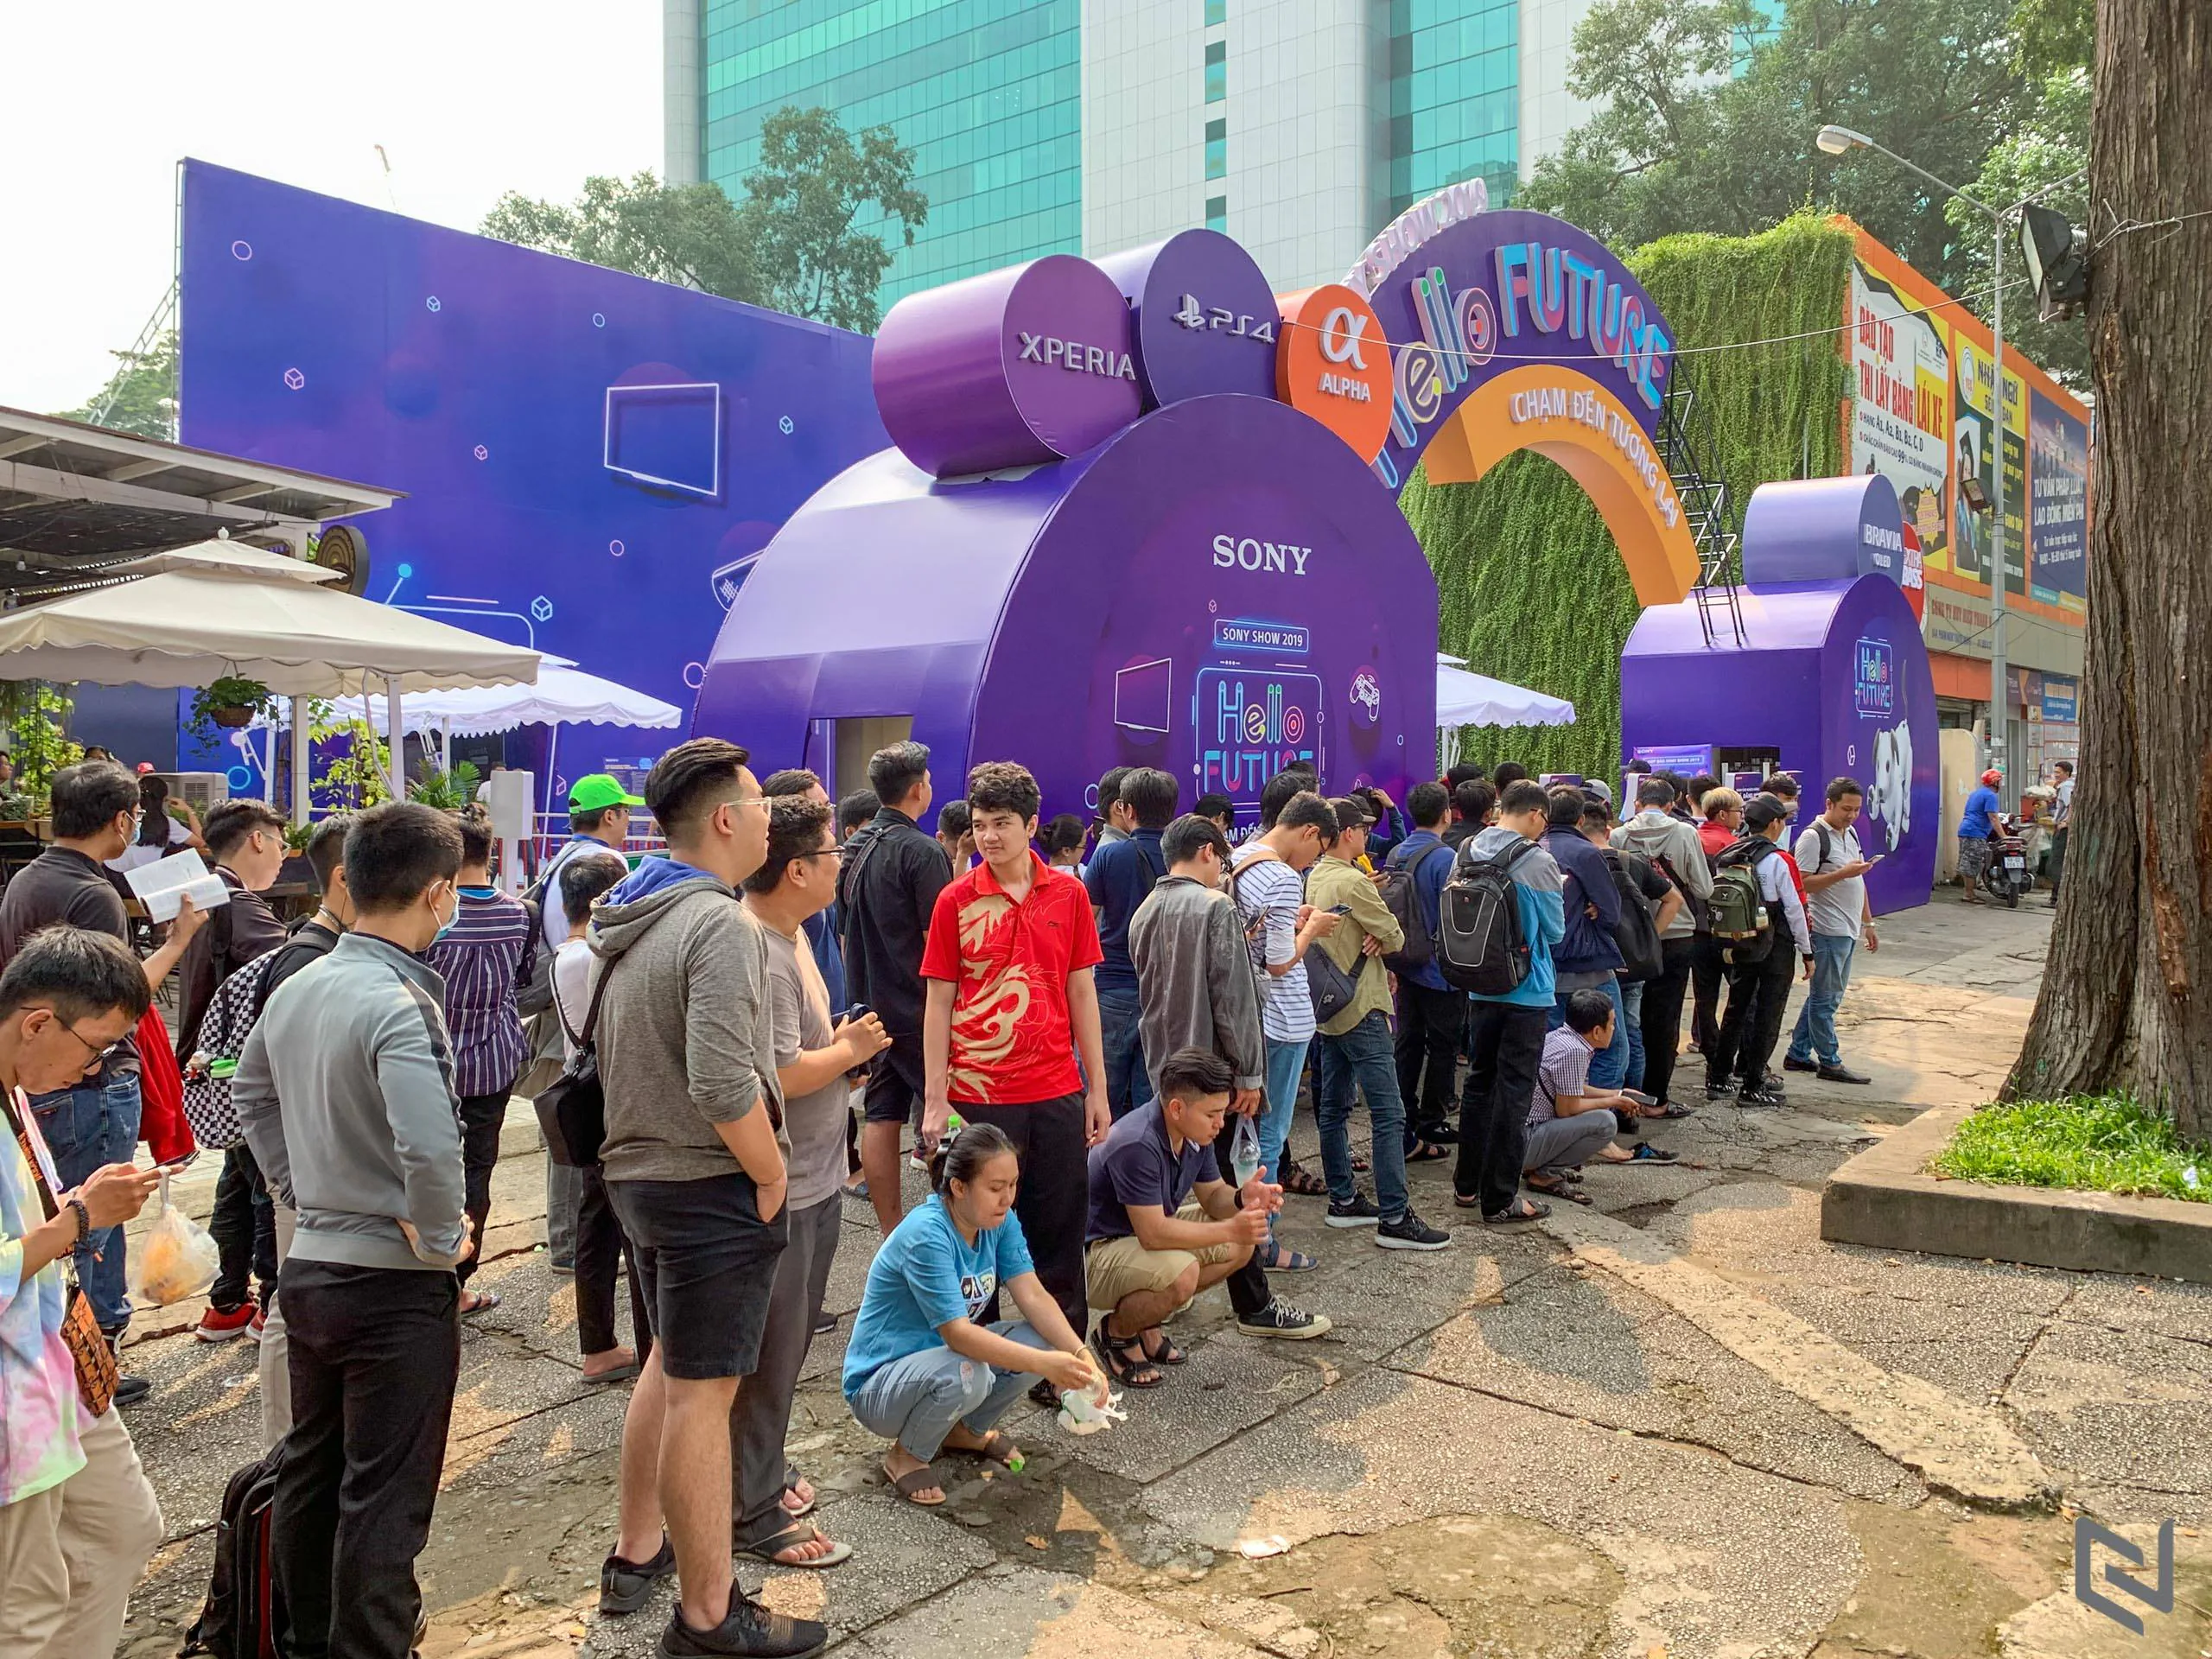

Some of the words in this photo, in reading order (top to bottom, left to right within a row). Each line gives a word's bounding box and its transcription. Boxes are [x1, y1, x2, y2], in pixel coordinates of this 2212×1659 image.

[1495, 242, 1670, 410] FUTURE
[1020, 331, 1137, 381] XPERIA
[1319, 372, 1372, 402] ALPHA
[1859, 359, 1872, 402] THI
[1916, 380, 1930, 433] LÁI
[1933, 394, 1942, 440] XE
[1510, 388, 1567, 423] CHẠM
[1570, 390, 1606, 430] ĐẾN
[1609, 410, 1659, 489] TƯƠNG
[1919, 437, 1923, 452] D
[1213, 534, 1312, 575] SONY
[1864, 524, 1903, 552] BRAVIA
[1223, 627, 1249, 642] SONY
[1252, 629, 1281, 645] SHOW
[1282, 632, 1303, 647] 2019
[1217, 680, 1305, 744] Hello
